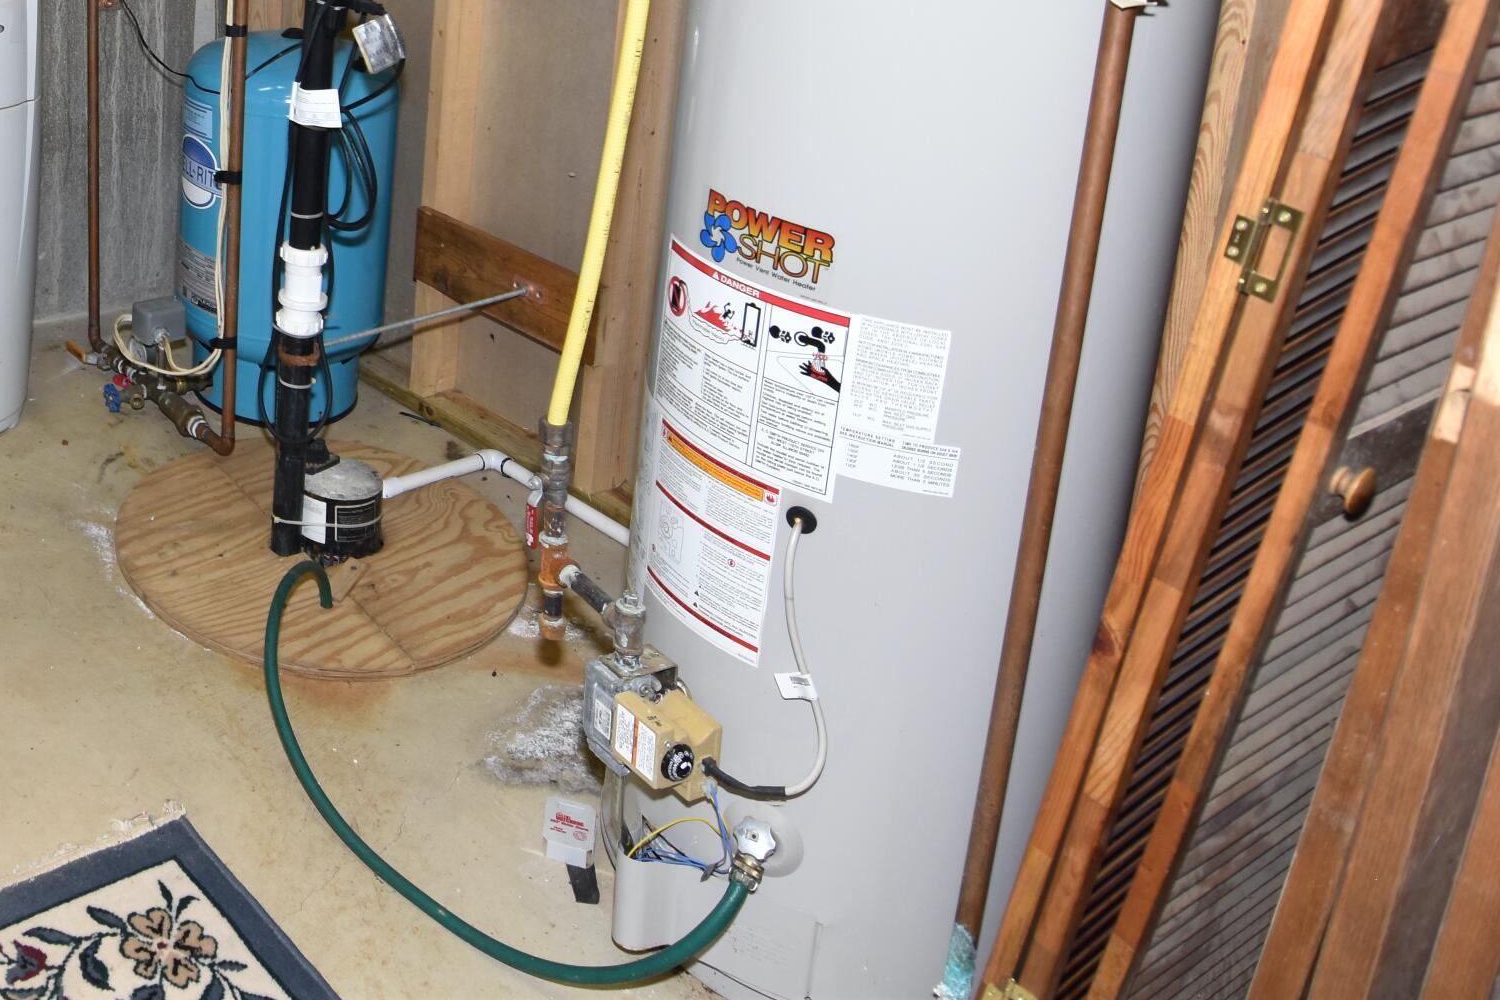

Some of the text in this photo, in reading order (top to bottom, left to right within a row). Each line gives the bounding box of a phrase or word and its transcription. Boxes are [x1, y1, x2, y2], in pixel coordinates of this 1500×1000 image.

[707, 188, 835, 263] POWER
[736, 257, 816, 292] Power Vent Water Heater
[737, 233, 831, 284] SHOT
[720, 275, 760, 298] DANGER
